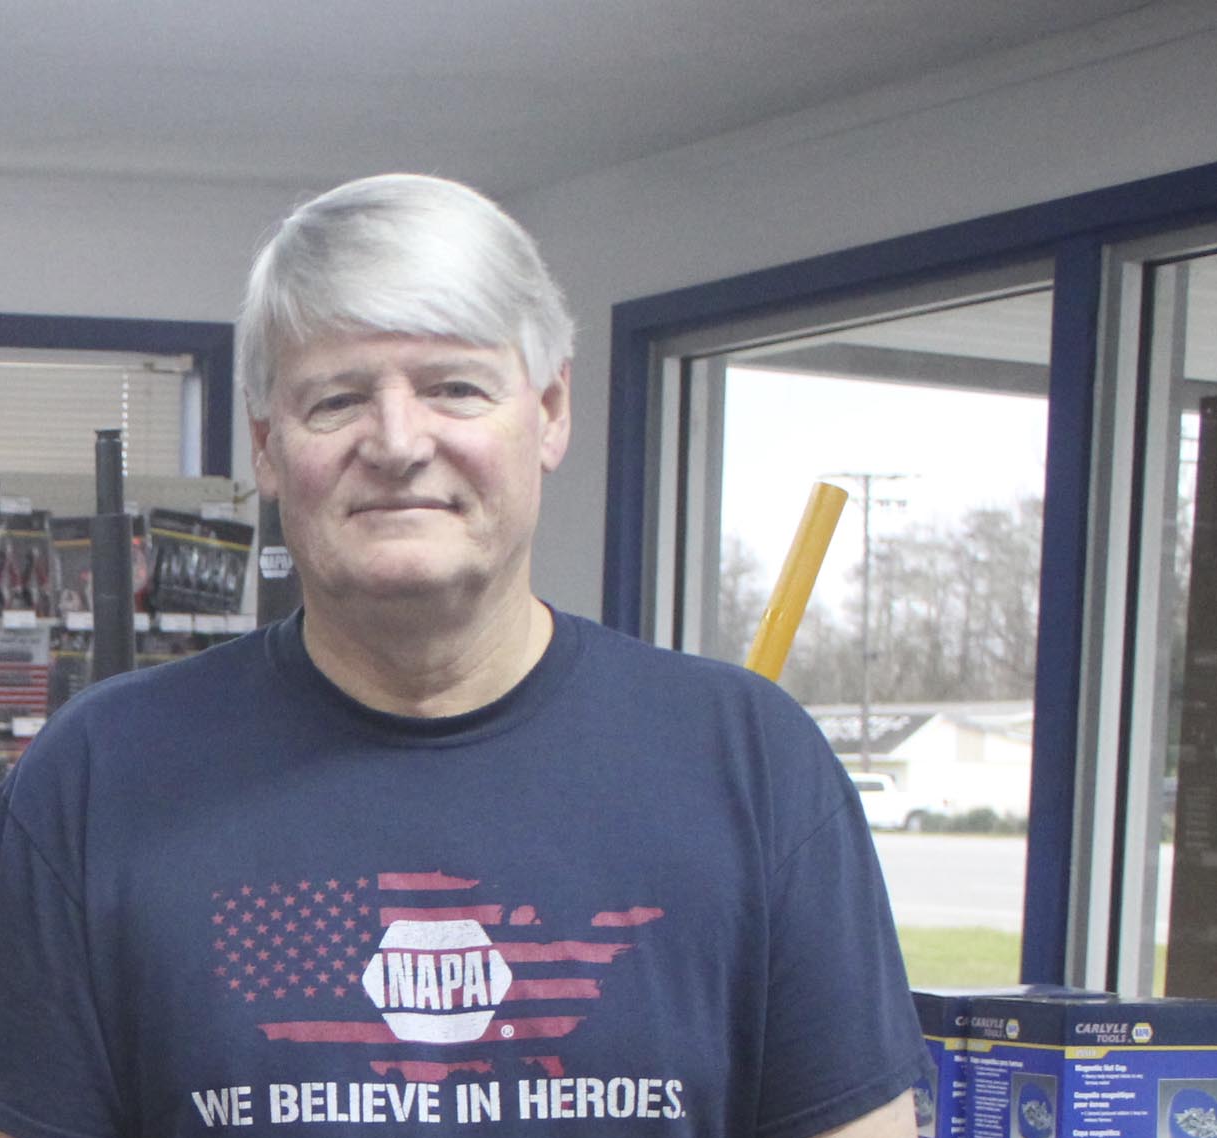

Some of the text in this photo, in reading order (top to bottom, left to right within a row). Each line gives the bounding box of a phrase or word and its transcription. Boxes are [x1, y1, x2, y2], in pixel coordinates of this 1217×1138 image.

[387, 948, 486, 1010] NAPA
[1075, 1023, 1128, 1034] CARLYLE
[1096, 1034, 1127, 1043] TOOLS
[192, 1086, 254, 1128] WE
[269, 1082, 441, 1124] BELIEVE
[456, 1081, 501, 1124] IN
